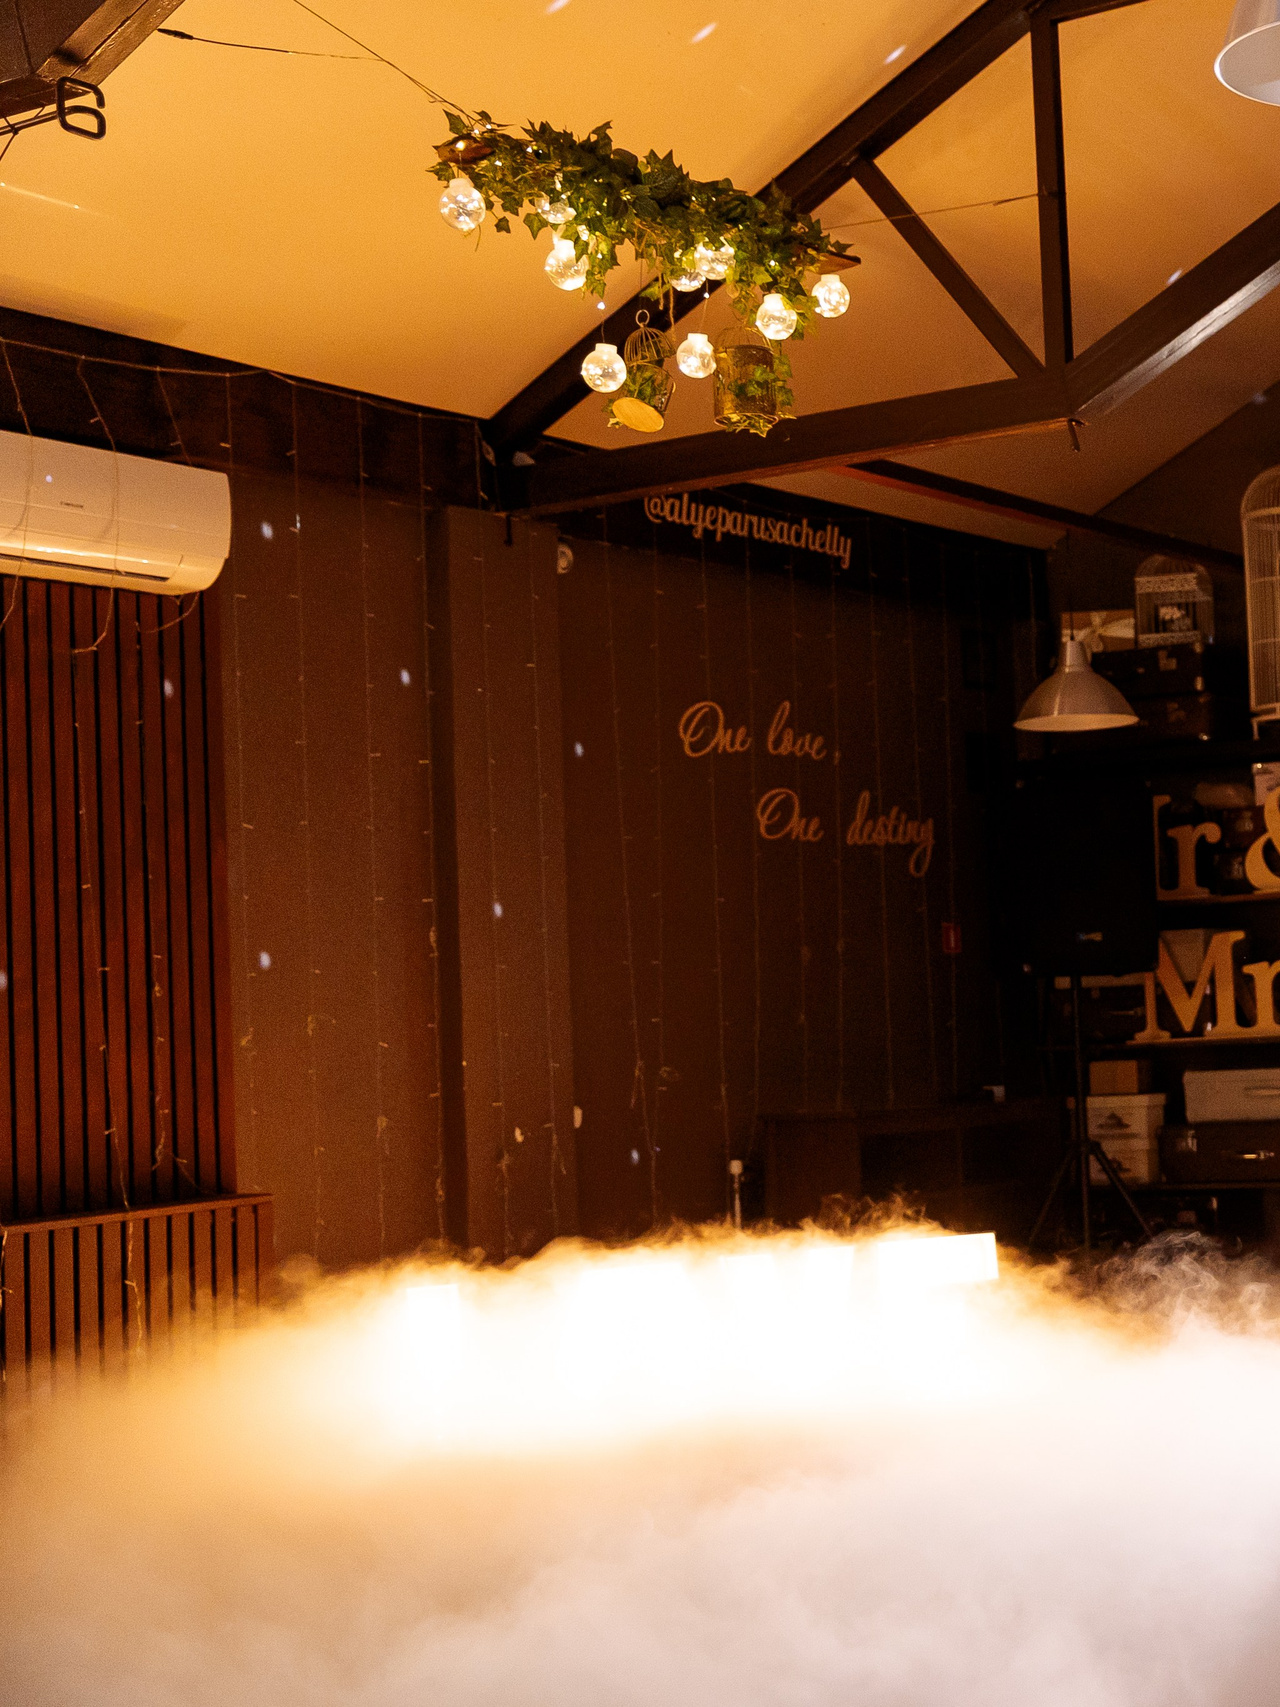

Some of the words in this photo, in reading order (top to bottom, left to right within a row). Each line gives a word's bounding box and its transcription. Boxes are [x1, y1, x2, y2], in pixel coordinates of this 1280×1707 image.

[678, 701, 752, 758] One
[757, 788, 824, 842] One
[846, 790, 935, 878] destiny
